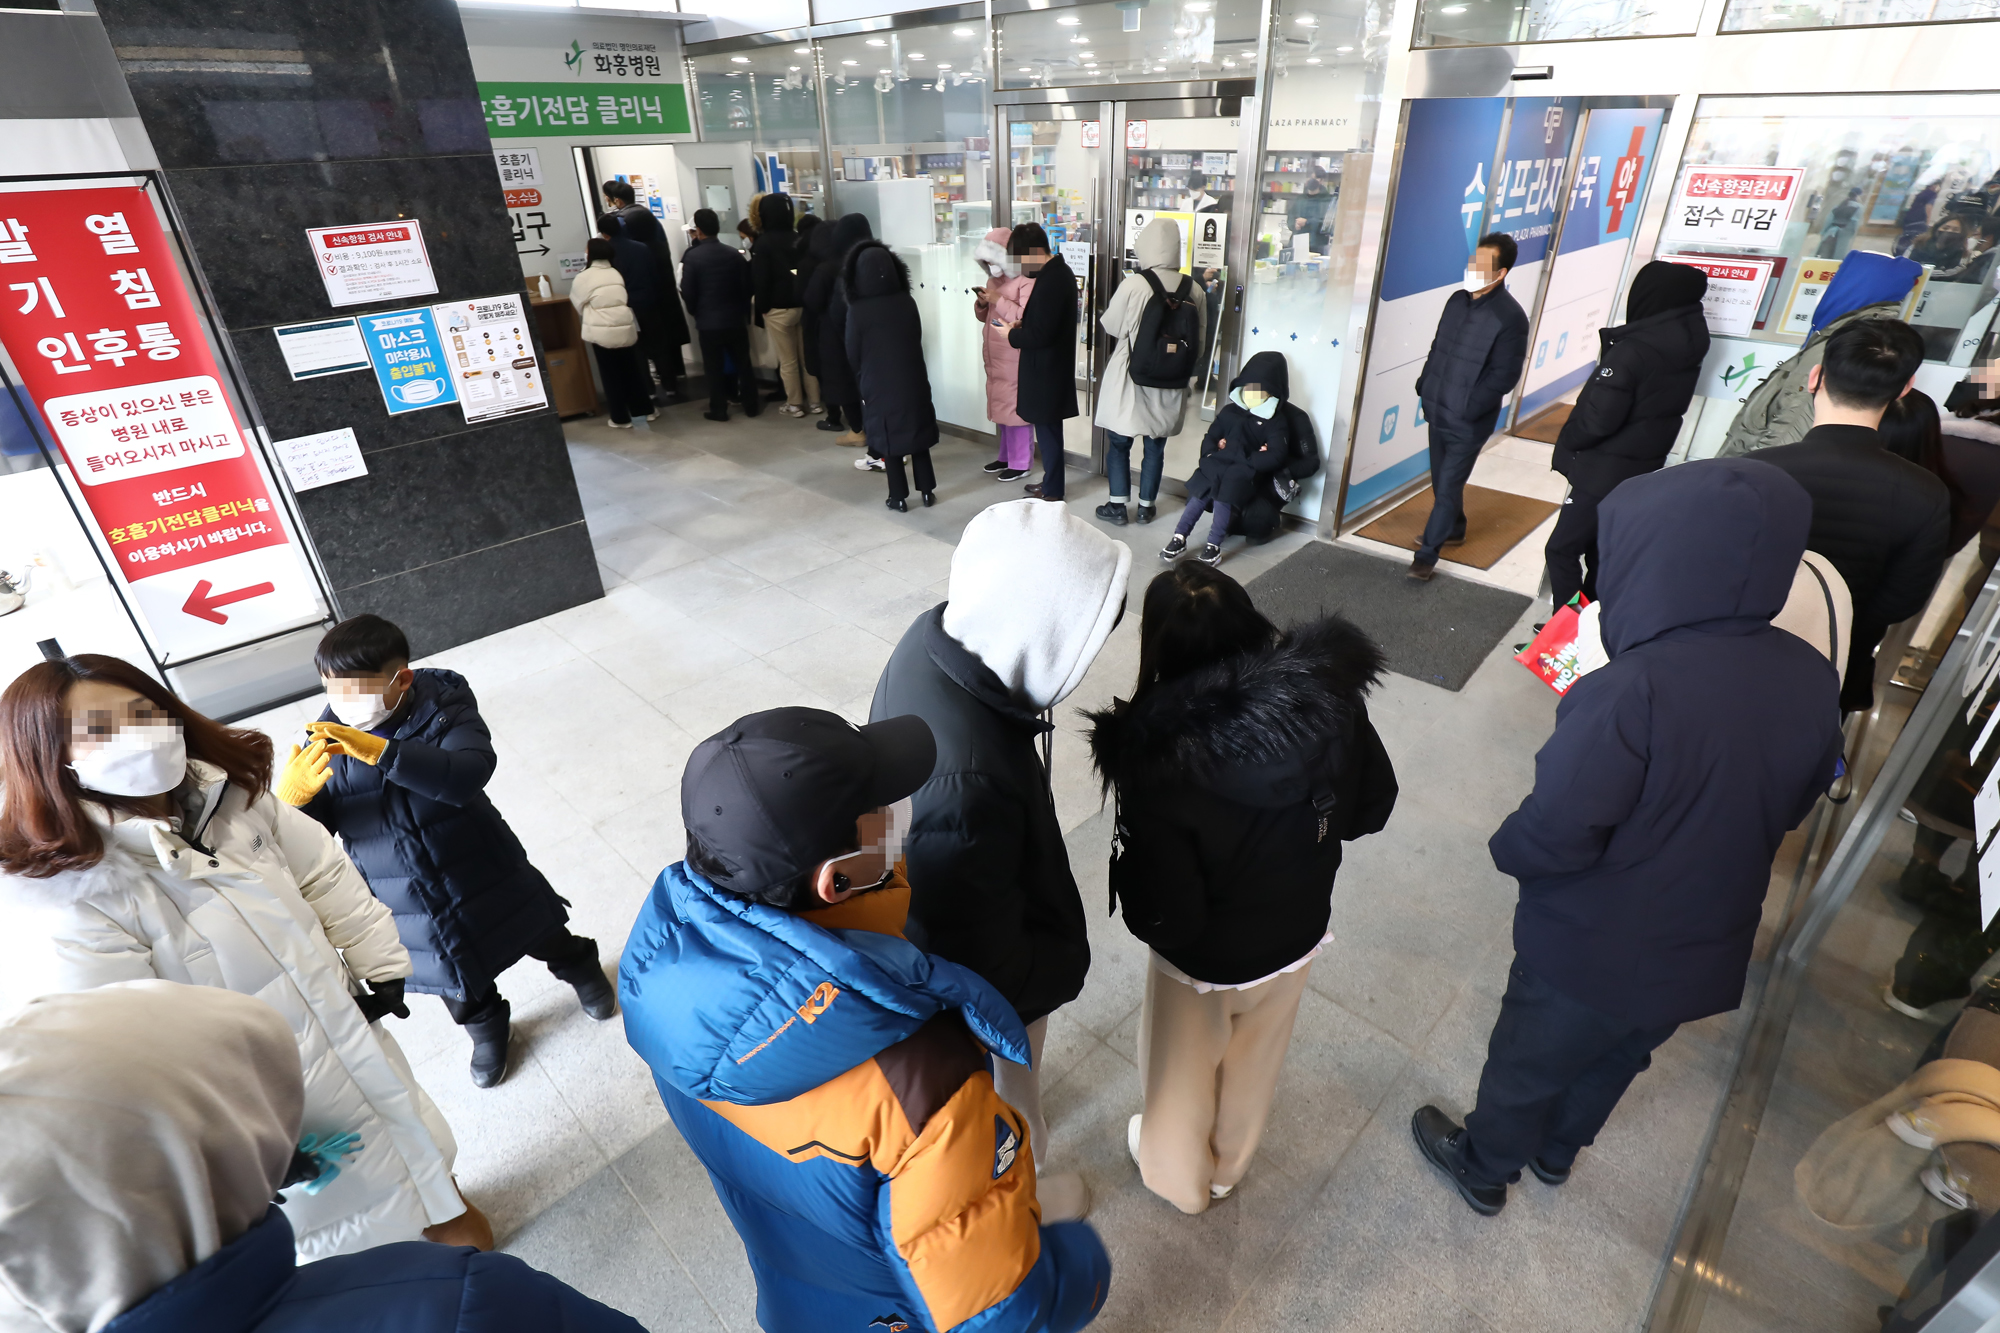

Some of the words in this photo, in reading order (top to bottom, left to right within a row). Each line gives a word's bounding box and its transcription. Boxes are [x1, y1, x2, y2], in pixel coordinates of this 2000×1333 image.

[592, 42, 618, 51] 의료법인
[594, 53, 662, 77] 화홍병원
[596, 95, 664, 125] 클리닉
[499, 153, 532, 167] 호흡기
[502, 168, 535, 181] 클리닉
[1616, 157, 1637, 212] 약
[504, 191, 539, 206] 수,수납
[1692, 178, 1786, 197] 신속항원검사
[1683, 205, 1725, 228] 접수
[1731, 207, 1778, 231] 마감
[85, 212, 140, 255] 열
[332, 234, 367, 247] 신속항원
[367, 232, 385, 242] 검사
[386, 230, 403, 240] 안내
[334, 252, 350, 261] 비용
[338, 262, 368, 273] 결과확인
[374, 262, 386, 270] 검사
[1711, 267, 1730, 277] 검사
[1730, 268, 1750, 279] 안내
[9, 276, 67, 319] 기
[110, 267, 162, 310] 침
[476, 303, 502, 313] 코로나19
[381, 319, 402, 327] 코로나19
[37, 321, 182, 375] 인후통
[378, 328, 427, 349] 마스크
[385, 346, 431, 364] 미착용시
[390, 361, 436, 380] 출입불가
[60, 403, 118, 427] 증상이
[121, 394, 177, 418] 있으신
[179, 389, 214, 409] 분은
[111, 423, 149, 443] 병원
[153, 417, 189, 436] 내로
[86, 442, 177, 473] 들어오시지
[179, 433, 231, 455] 마시고
[152, 482, 208, 507] 반드시
[109, 497, 270, 545] 호흡기전담클리닉을
[128, 535, 208, 564] 이용하시기
[207, 520, 273, 544] 바랍니다.
[796, 981, 841, 1025] K2
